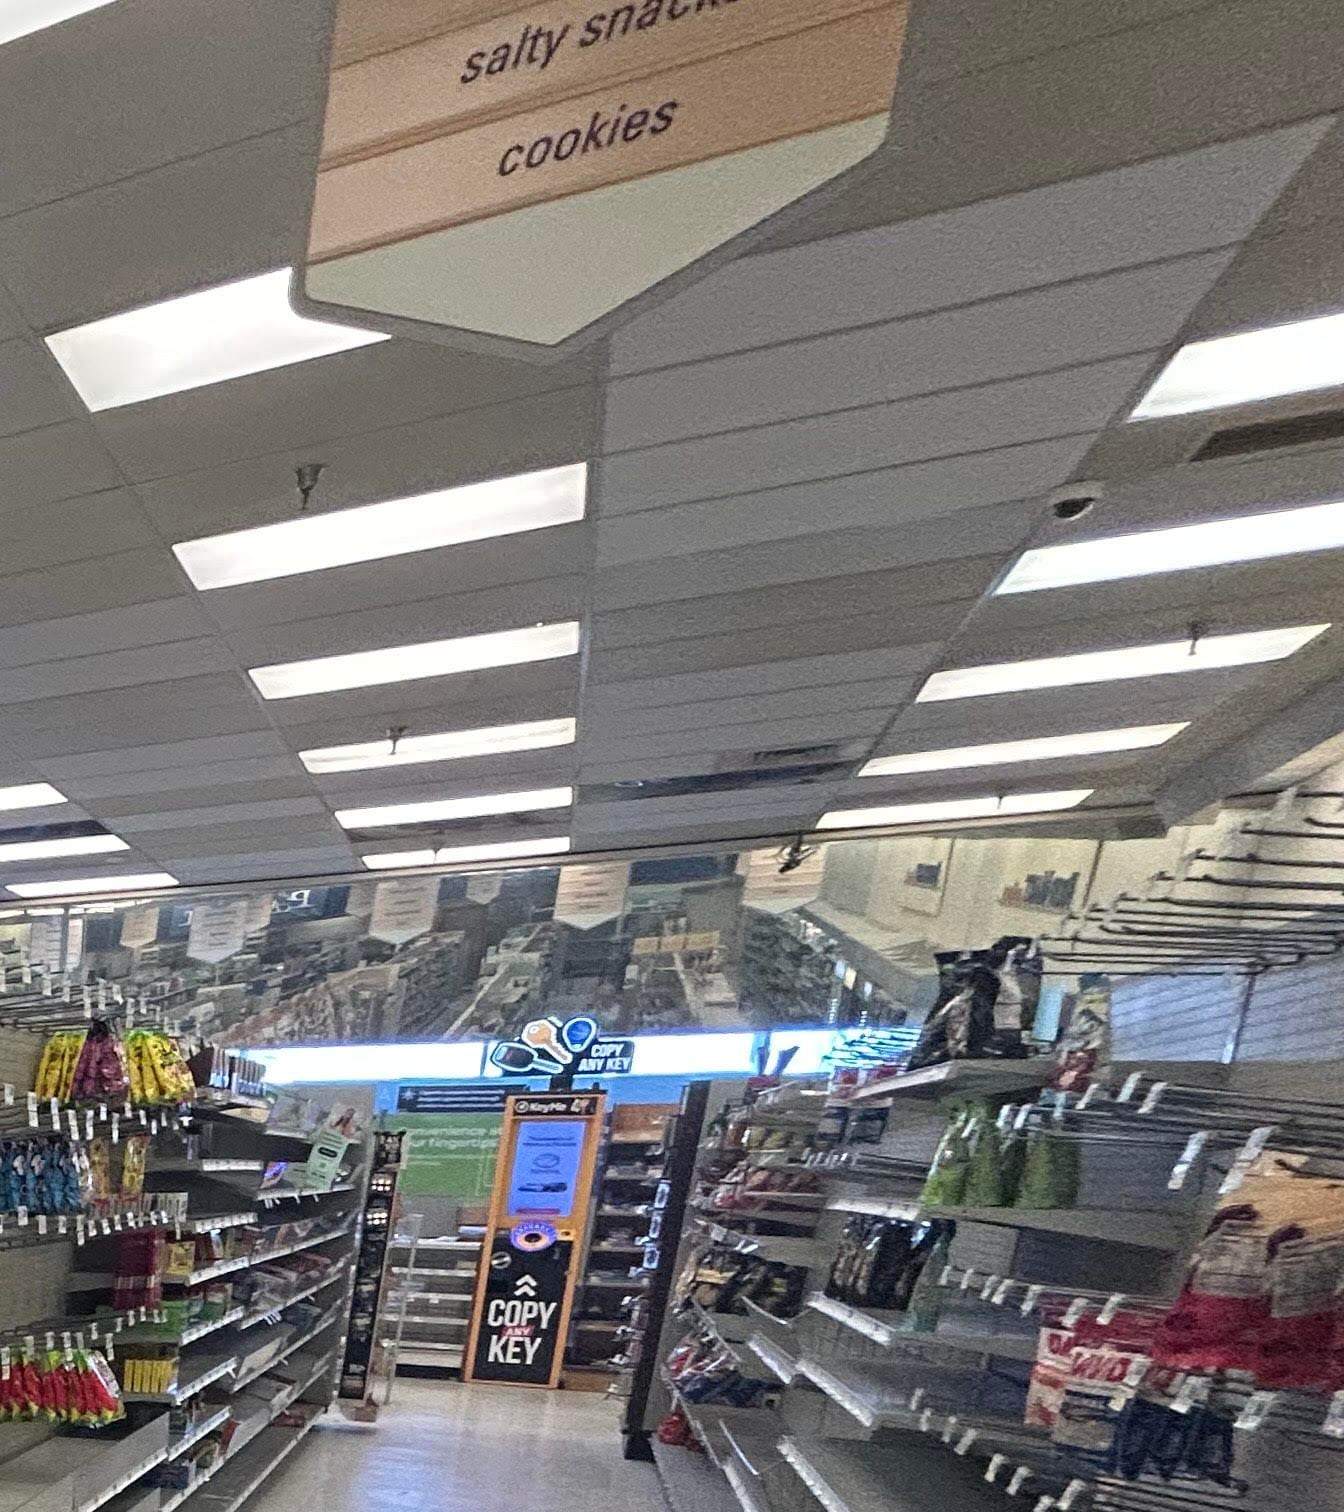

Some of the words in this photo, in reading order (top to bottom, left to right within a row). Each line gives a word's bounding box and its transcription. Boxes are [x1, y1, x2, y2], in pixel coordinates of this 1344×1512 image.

[459, 22, 571, 85] salty
[579, 0, 739, 48] snac
[497, 99, 680, 178] cookies
[577, 1058, 605, 1072] ANY
[605, 1057, 632, 1071] KEY
[591, 1043, 625, 1058] COPY
[487, 1299, 557, 1330] COPY
[505, 1326, 532, 1337] ANY
[487, 1334, 542, 1365] KEY
